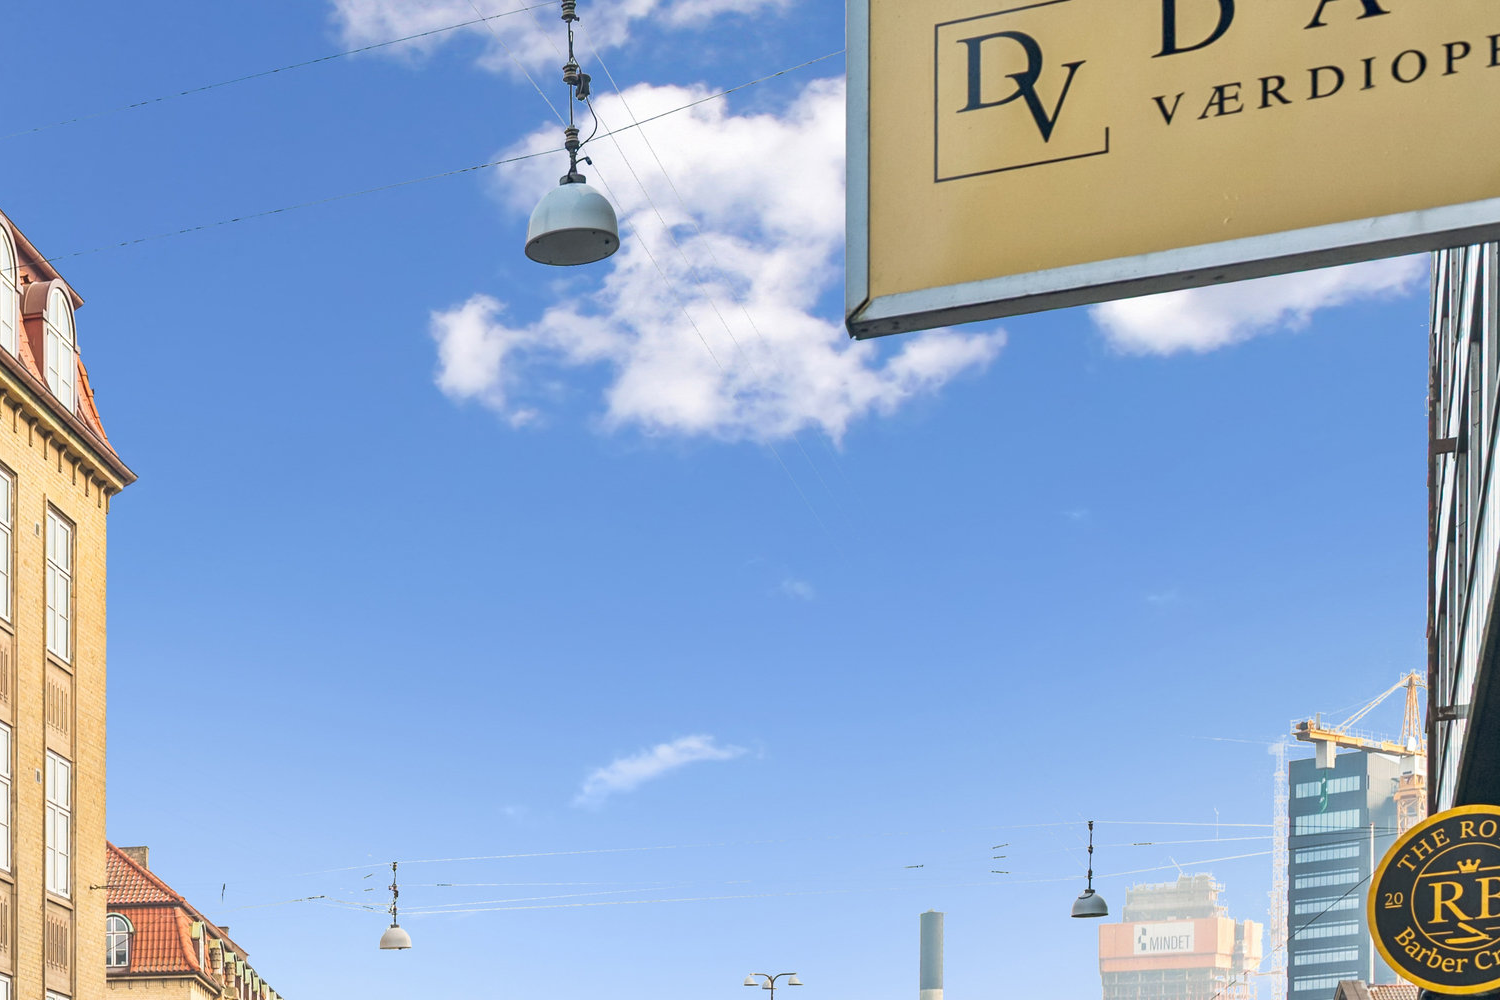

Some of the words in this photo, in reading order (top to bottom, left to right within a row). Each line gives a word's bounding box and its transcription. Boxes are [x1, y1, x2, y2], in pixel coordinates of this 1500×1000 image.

[956, 30, 1087, 143] DV
[1397, 828, 1450, 872] THE
[1460, 819, 1500, 841] RO
[1384, 893, 1404, 906] 20
[1149, 935, 1190, 951] MINDET
[1394, 926, 1468, 973] Barber
